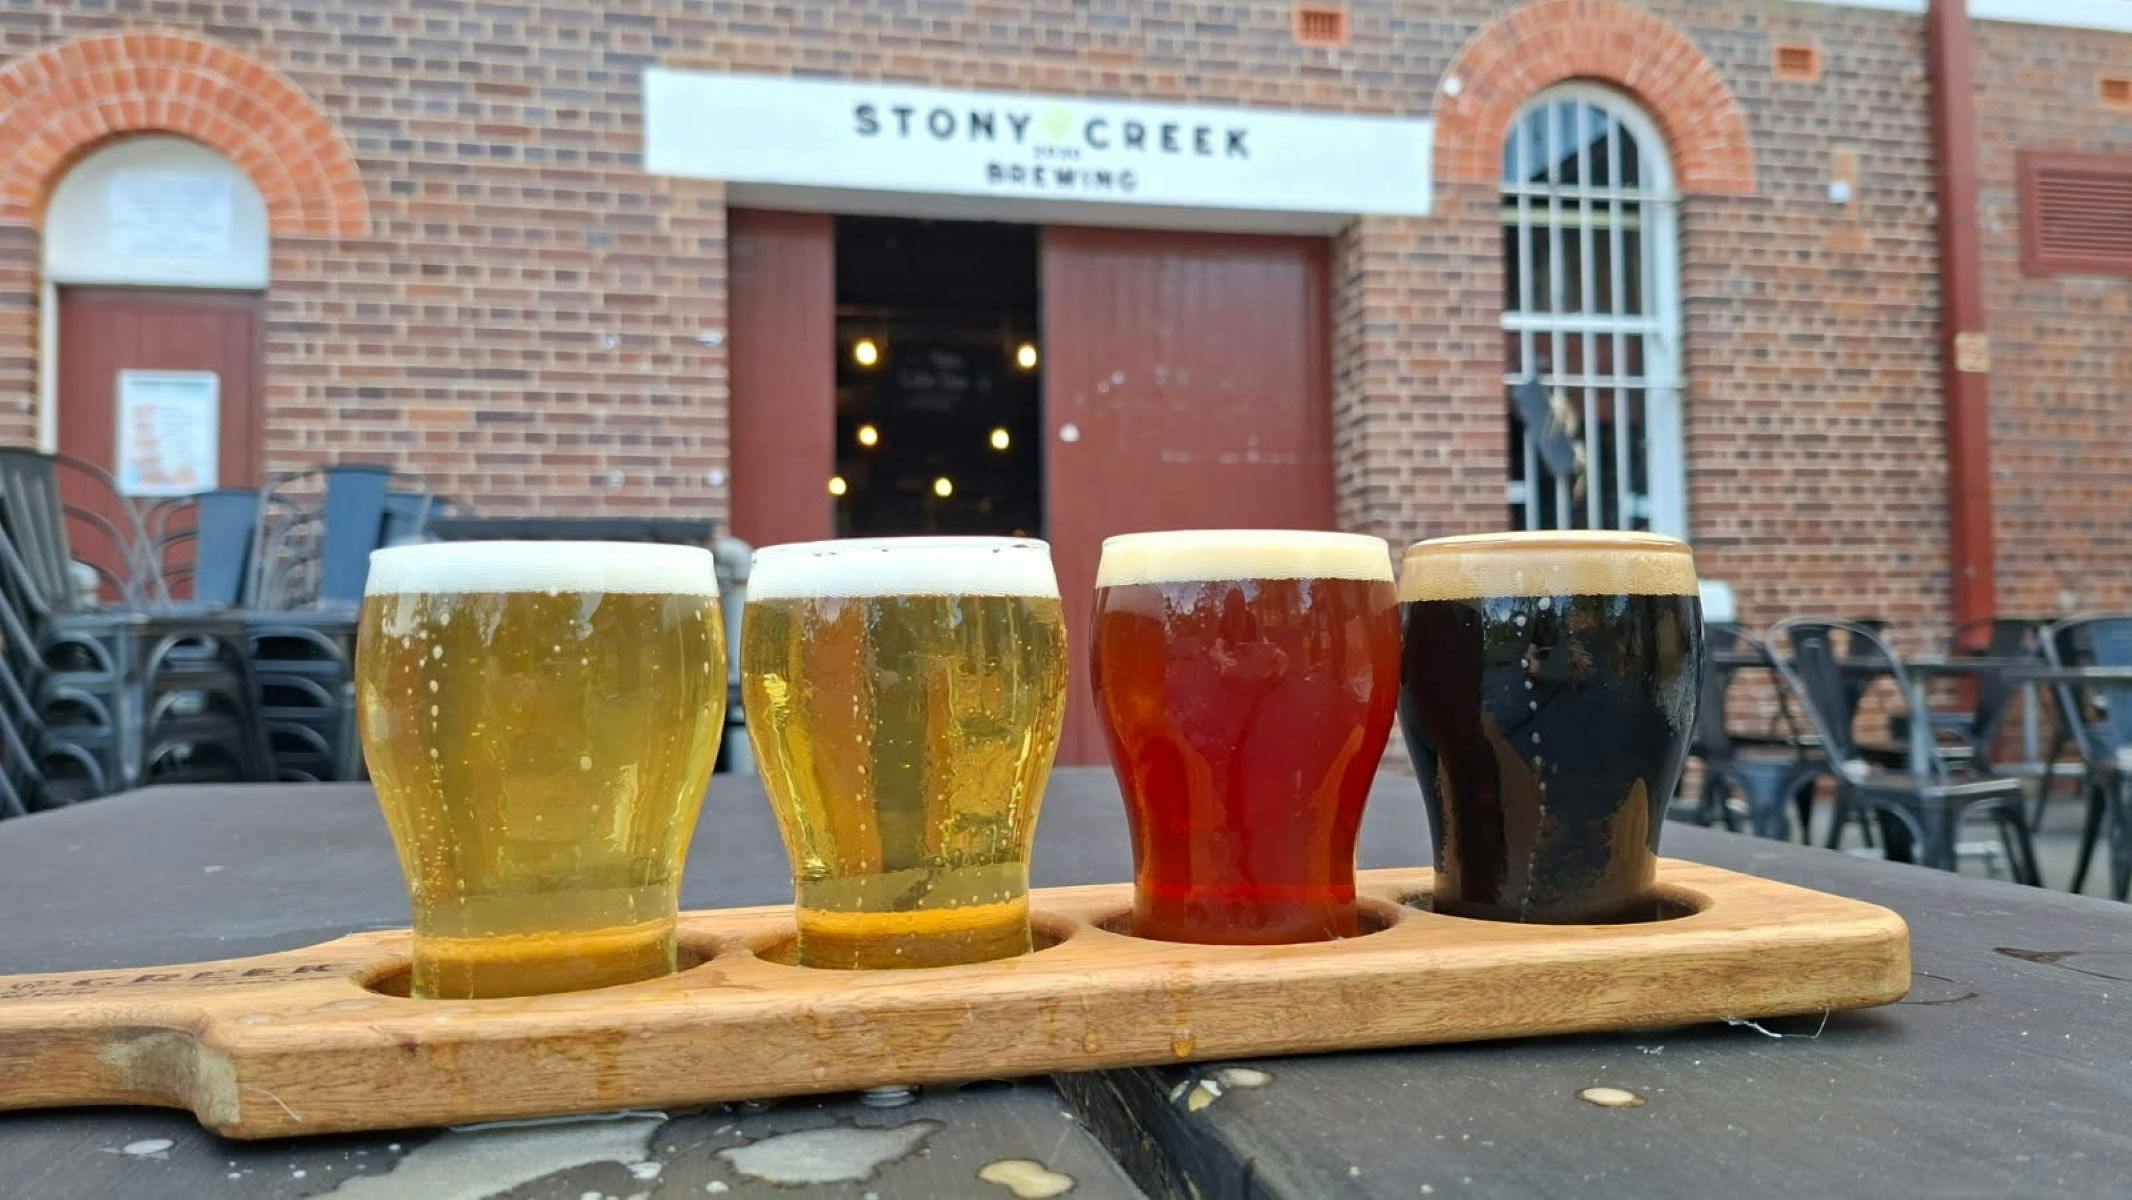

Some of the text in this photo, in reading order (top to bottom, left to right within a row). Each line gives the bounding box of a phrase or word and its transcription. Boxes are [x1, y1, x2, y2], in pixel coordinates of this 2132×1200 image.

[853, 102, 1031, 141] STONY
[1085, 118, 1250, 158] CREEK
[986, 162, 1138, 192] BREWING
[72, 964, 331, 987] CREEK
